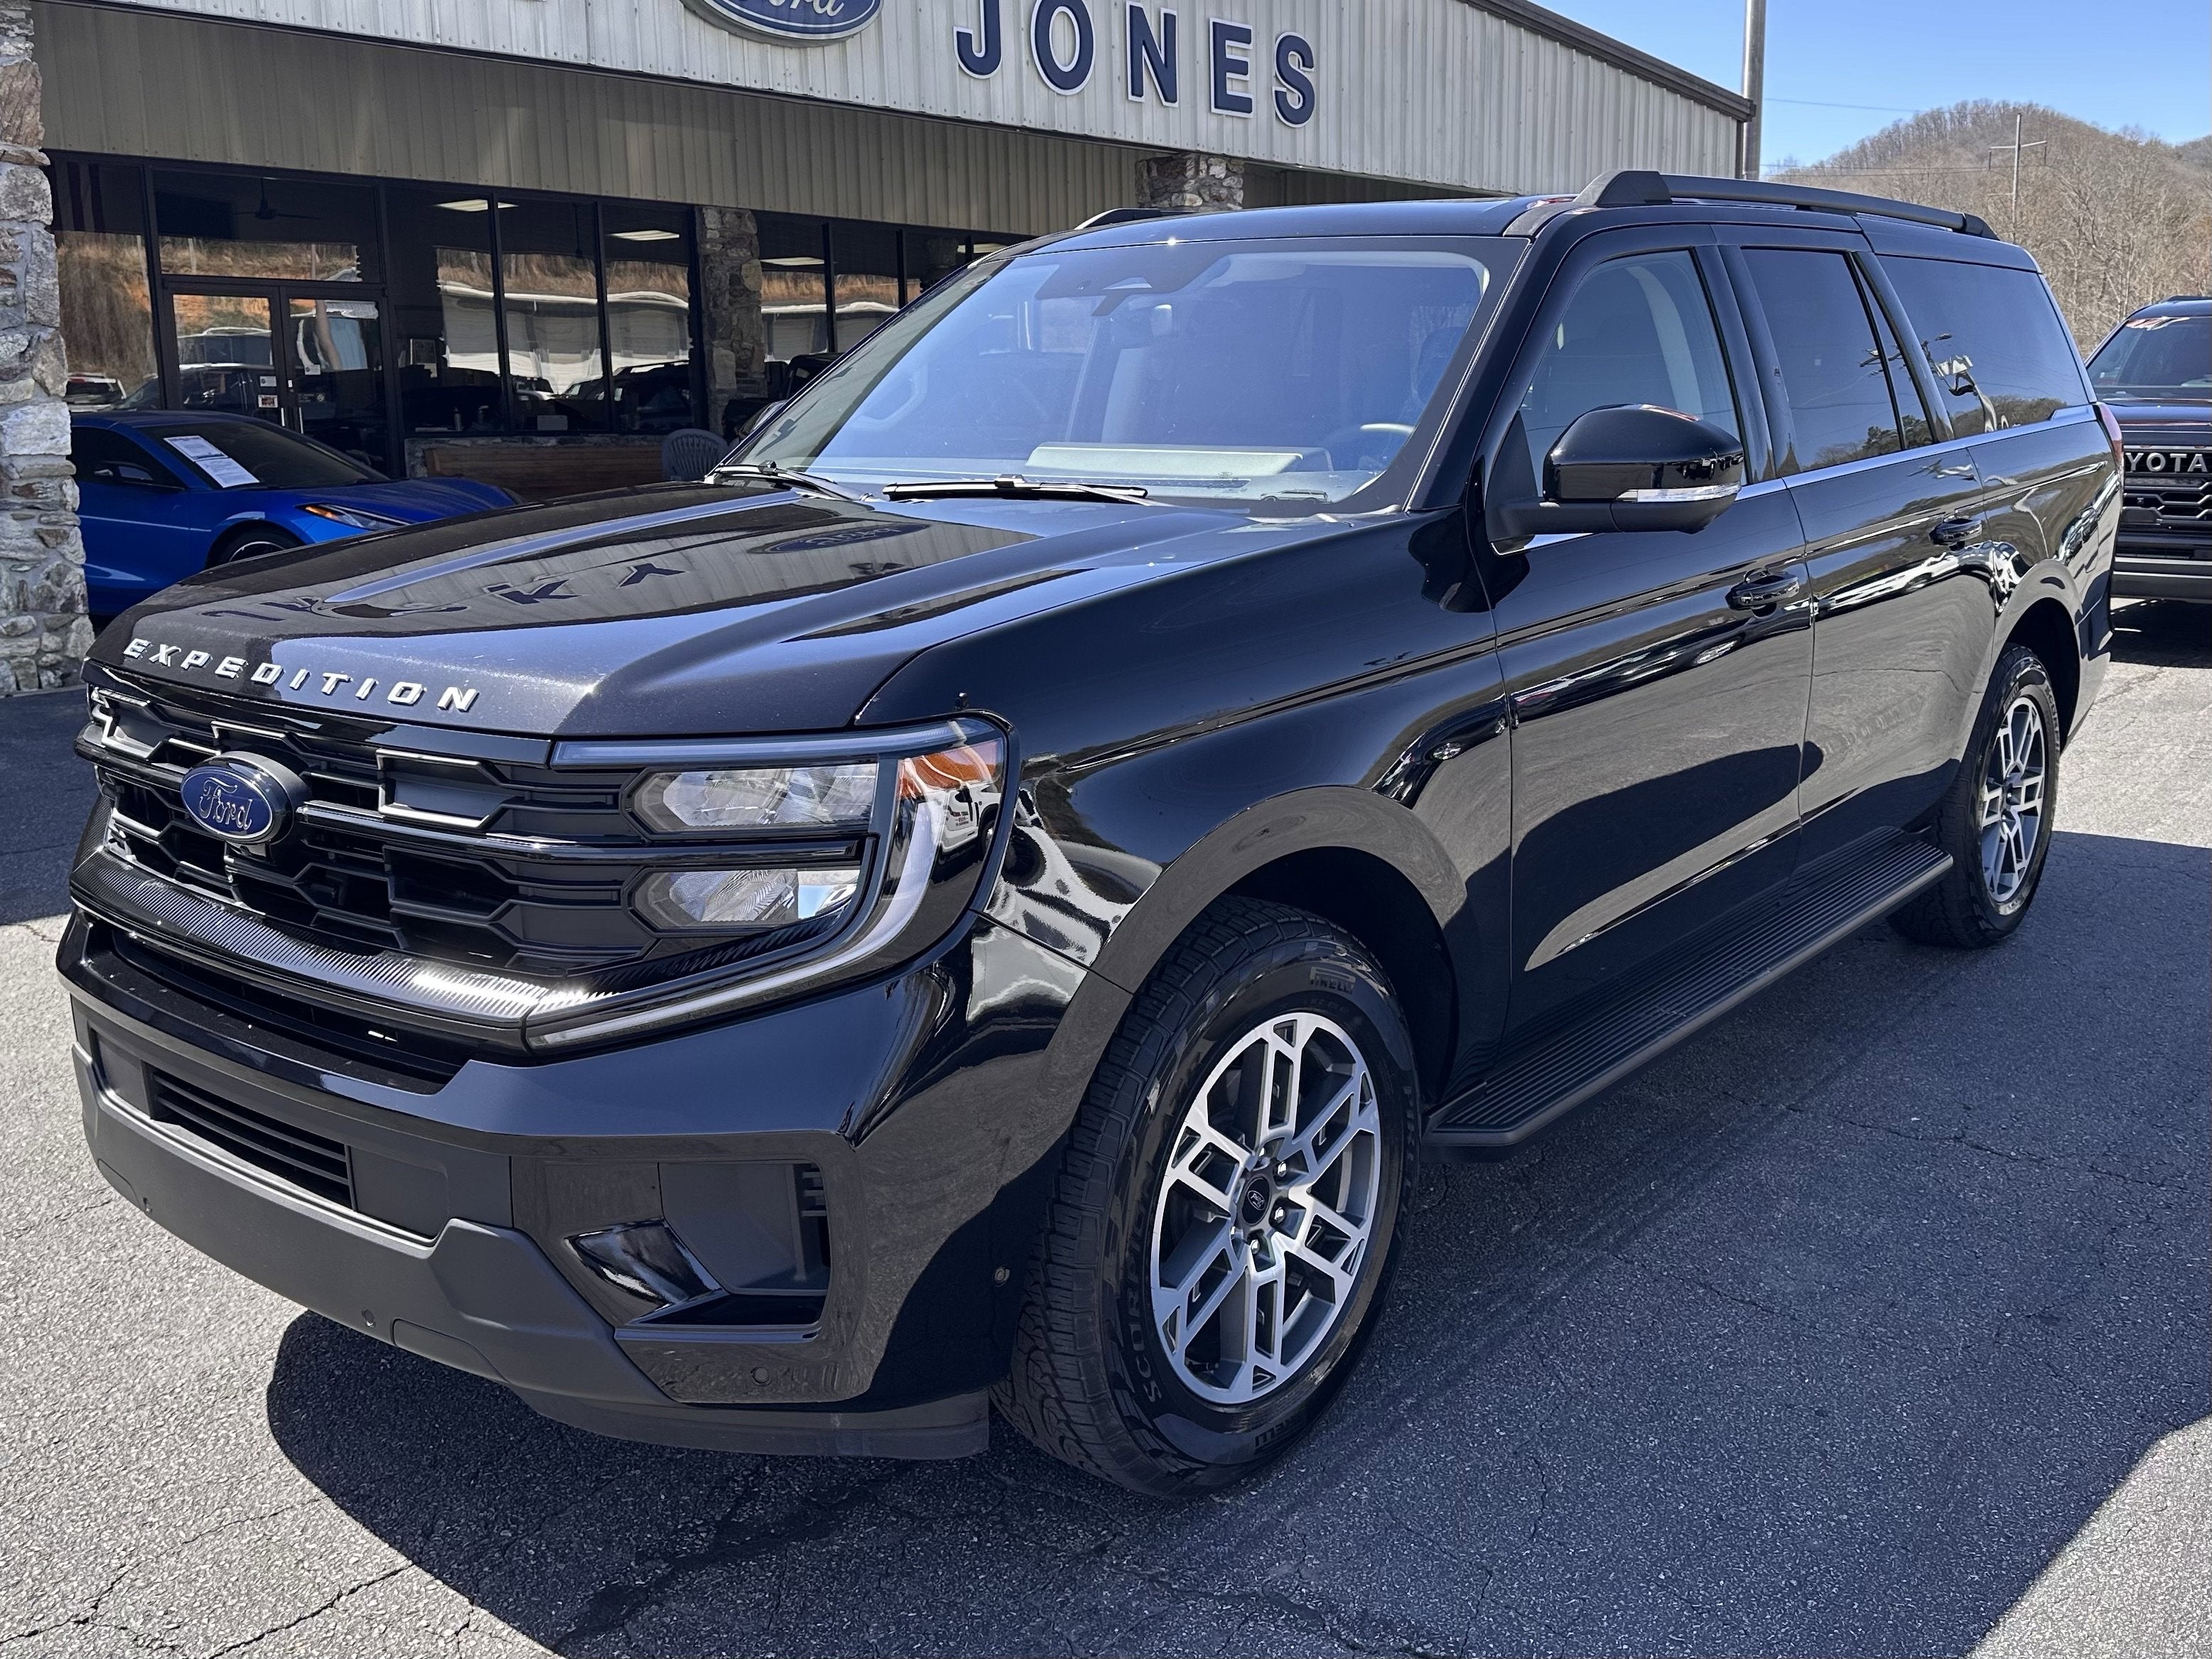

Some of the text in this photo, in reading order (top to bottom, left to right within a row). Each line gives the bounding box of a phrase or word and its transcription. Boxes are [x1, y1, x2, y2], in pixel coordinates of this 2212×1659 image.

[954, 0, 1315, 128] JONES
[2125, 453, 2208, 472] YOTA
[123, 637, 480, 712] EXPEDITION
[198, 776, 252, 830] Ford
